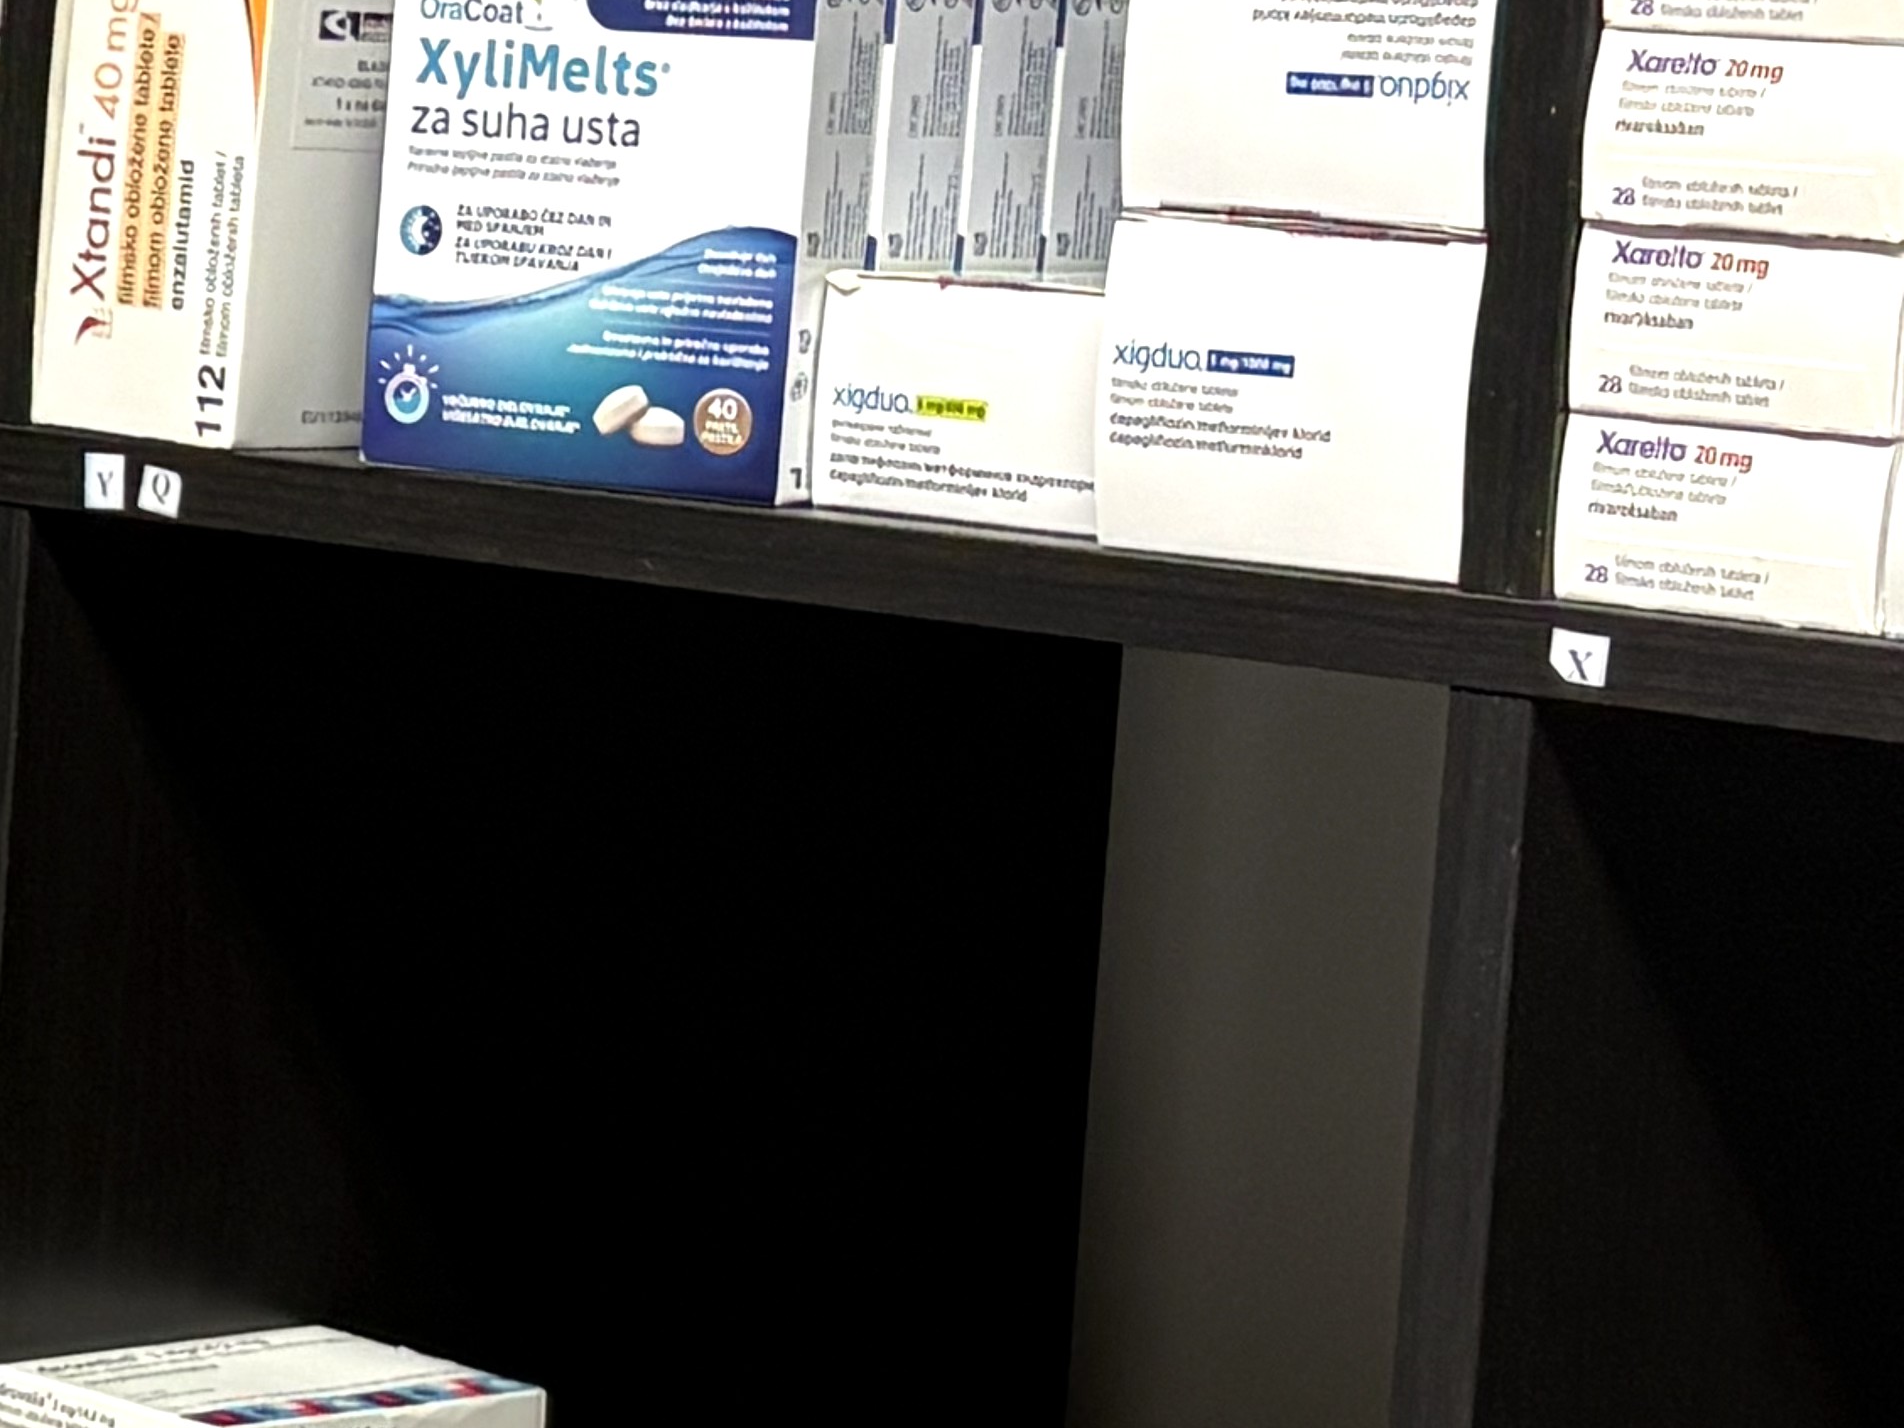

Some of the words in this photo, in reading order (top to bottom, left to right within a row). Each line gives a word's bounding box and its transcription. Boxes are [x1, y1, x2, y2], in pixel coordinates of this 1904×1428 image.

[94, 61, 124, 121] 40
[416, 36, 659, 100] XyliMelts
[411, 103, 450, 136] za
[461, 102, 550, 142] suha
[563, 111, 641, 148] usta
[70, 135, 119, 302] Xtandi
[195, 364, 228, 439] 112
[708, 397, 738, 420] 40
[151, 473, 171, 506] Q
[1567, 648, 1593, 682] X
